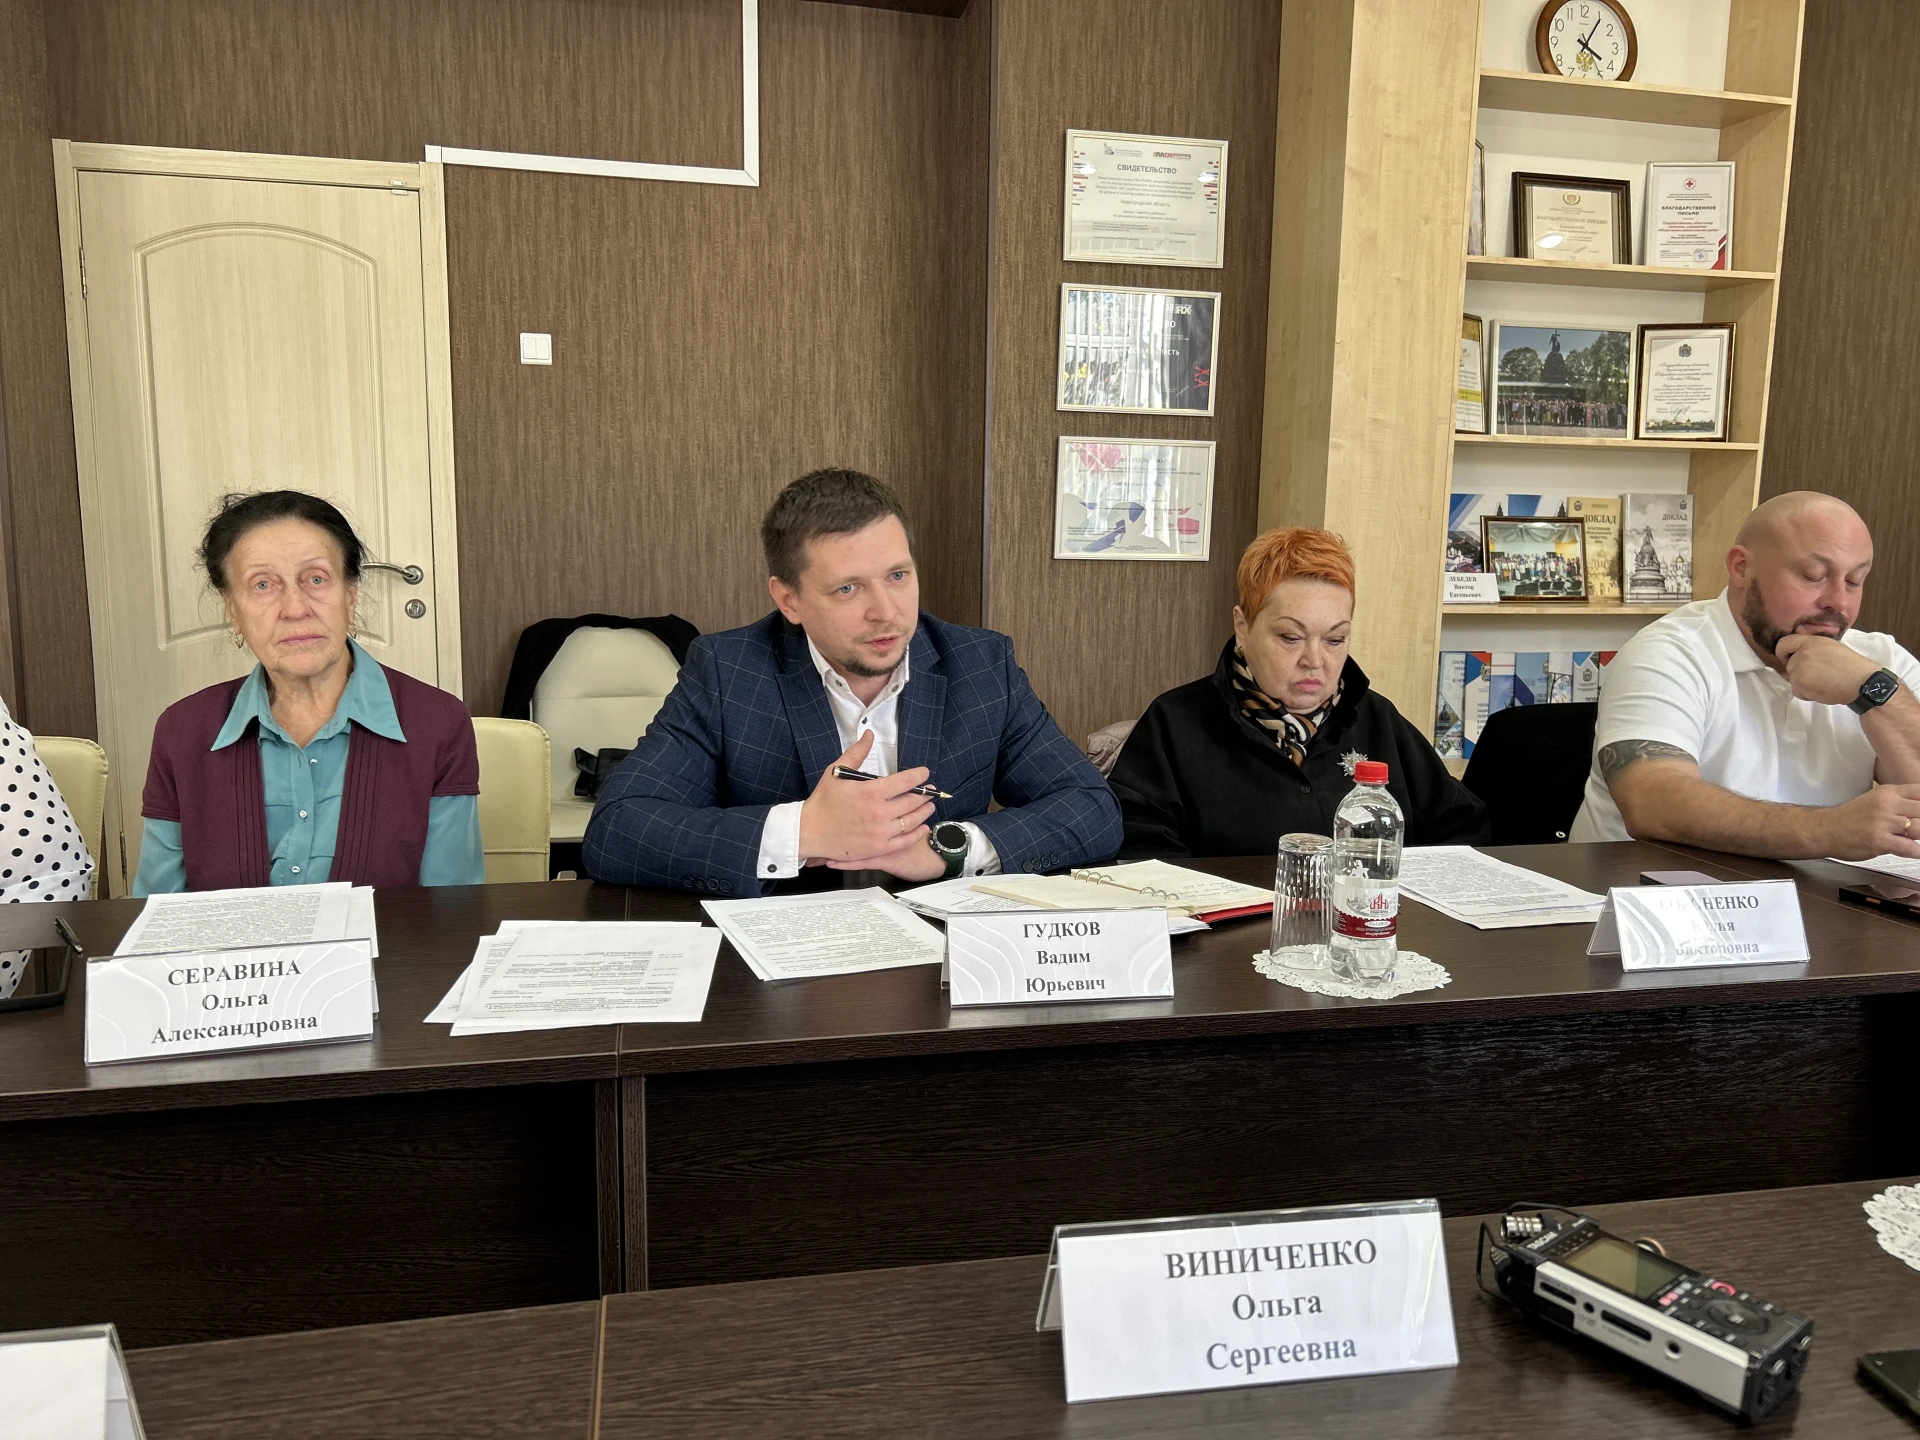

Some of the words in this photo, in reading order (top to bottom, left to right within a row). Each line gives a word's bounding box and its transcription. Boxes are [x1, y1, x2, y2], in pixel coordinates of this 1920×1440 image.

[1566, 8, 1574, 20] 11
[1580, 4, 1590, 18] 12
[1554, 18, 1565, 32] 10
[1606, 23, 1614, 37] 2
[1550, 35, 1559, 49] 9
[1611, 42, 1619, 55] 3
[1555, 54, 1563, 67] 8
[1606, 60, 1614, 71] 4
[1117, 163, 1177, 174] СВИДЕТЕЛЬСТВО
[1583, 514, 1617, 525] ДОКЛАД
[1662, 513, 1688, 521] ДОКЛАД
[1023, 921, 1101, 940] ГУДКОВ
[1036, 950, 1091, 965] Вадим
[167, 959, 302, 986] СЕРАВИНА
[1025, 977, 1106, 996] Юрьевич
[201, 992, 269, 1011] Ольга
[151, 1015, 319, 1045] Александровна
[1526, 1231, 1559, 1250] TASCAM
[1165, 1237, 1378, 1279] ВИНИЧЕНКО
[1231, 1292, 1324, 1321] Ольга
[1205, 1337, 1358, 1375] Сергеевна
